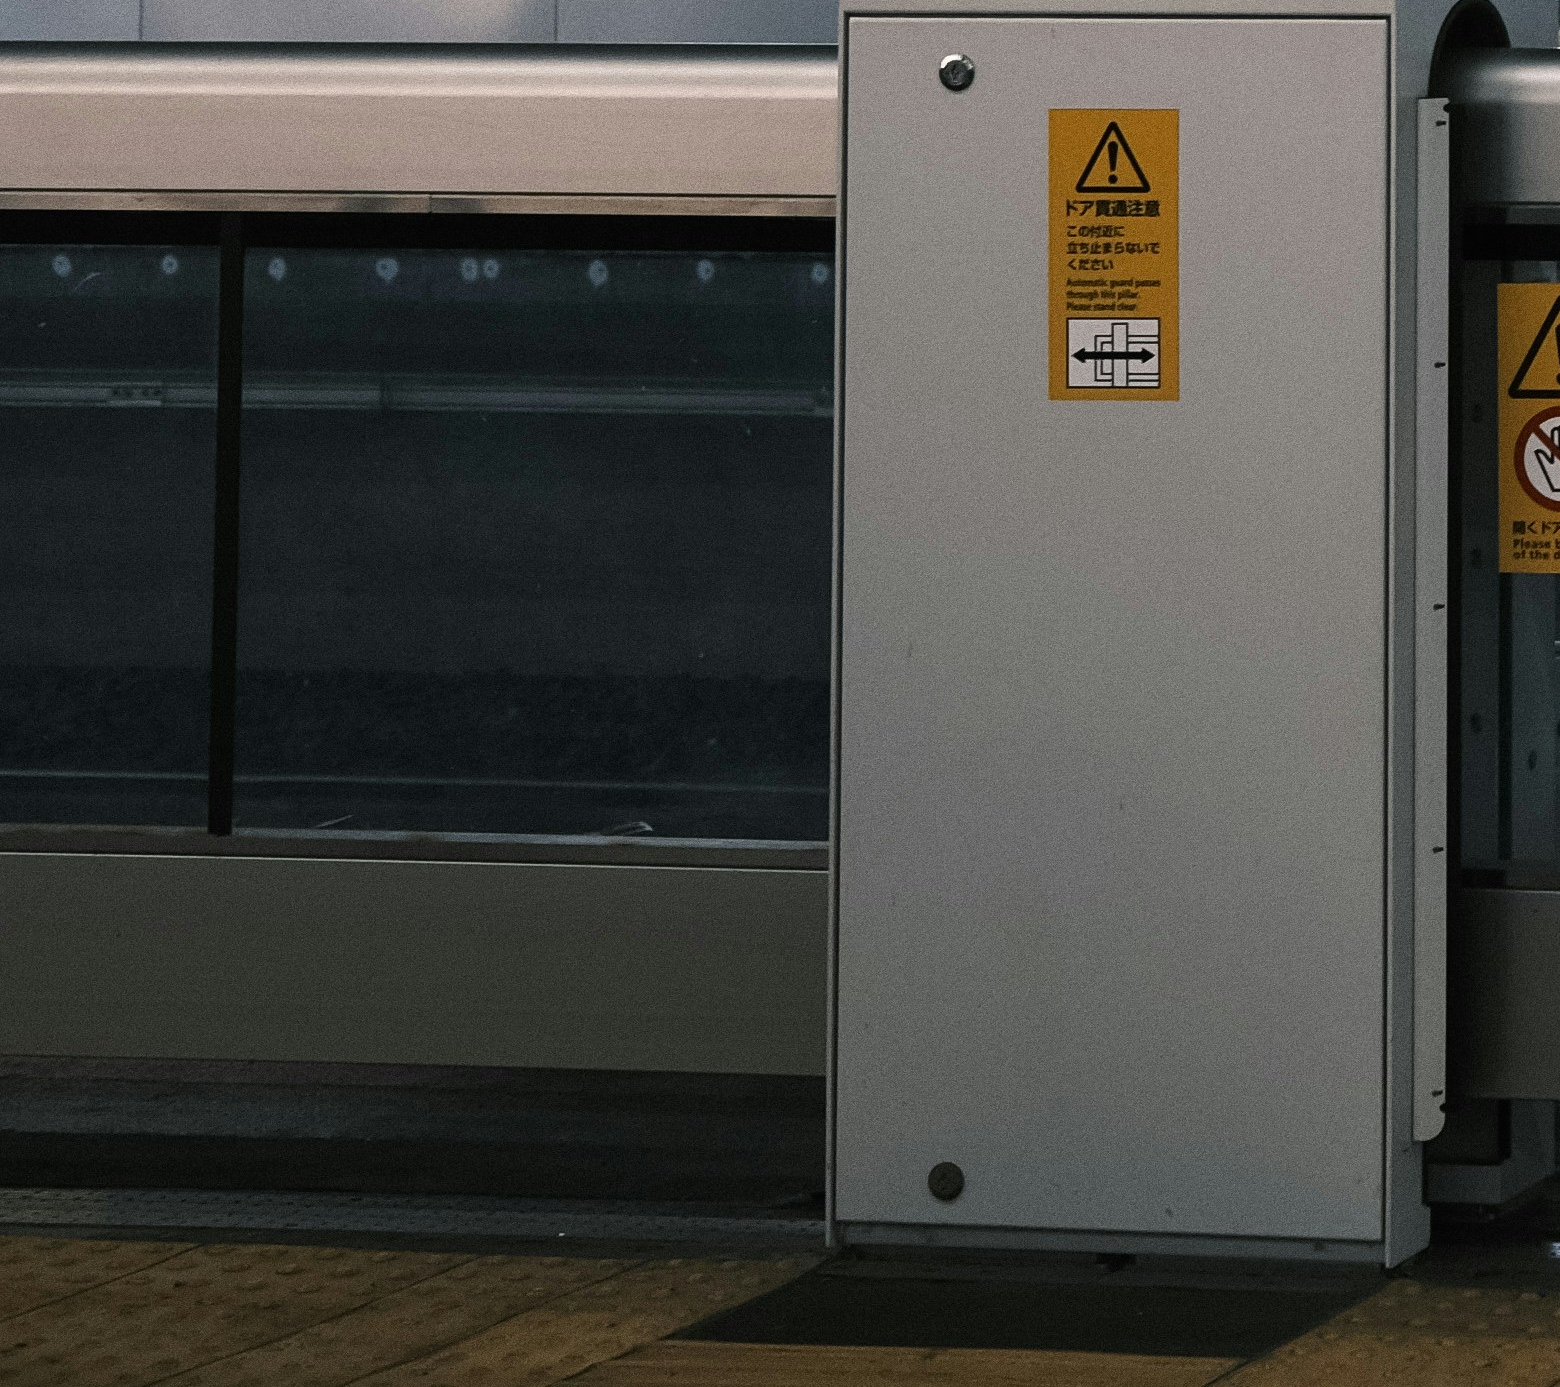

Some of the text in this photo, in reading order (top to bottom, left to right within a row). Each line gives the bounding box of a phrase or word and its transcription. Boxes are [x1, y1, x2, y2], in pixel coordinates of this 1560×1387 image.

[1066, 199, 1160, 217] ドア貫通注意
[1067, 225, 1125, 237] この付近に
[1066, 241, 1160, 254] 立ち止まらないで
[1067, 259, 1114, 270] ください
[1513, 539, 1551, 548] Please
[1513, 550, 1525, 559] of
[1529, 550, 1549, 559] the
